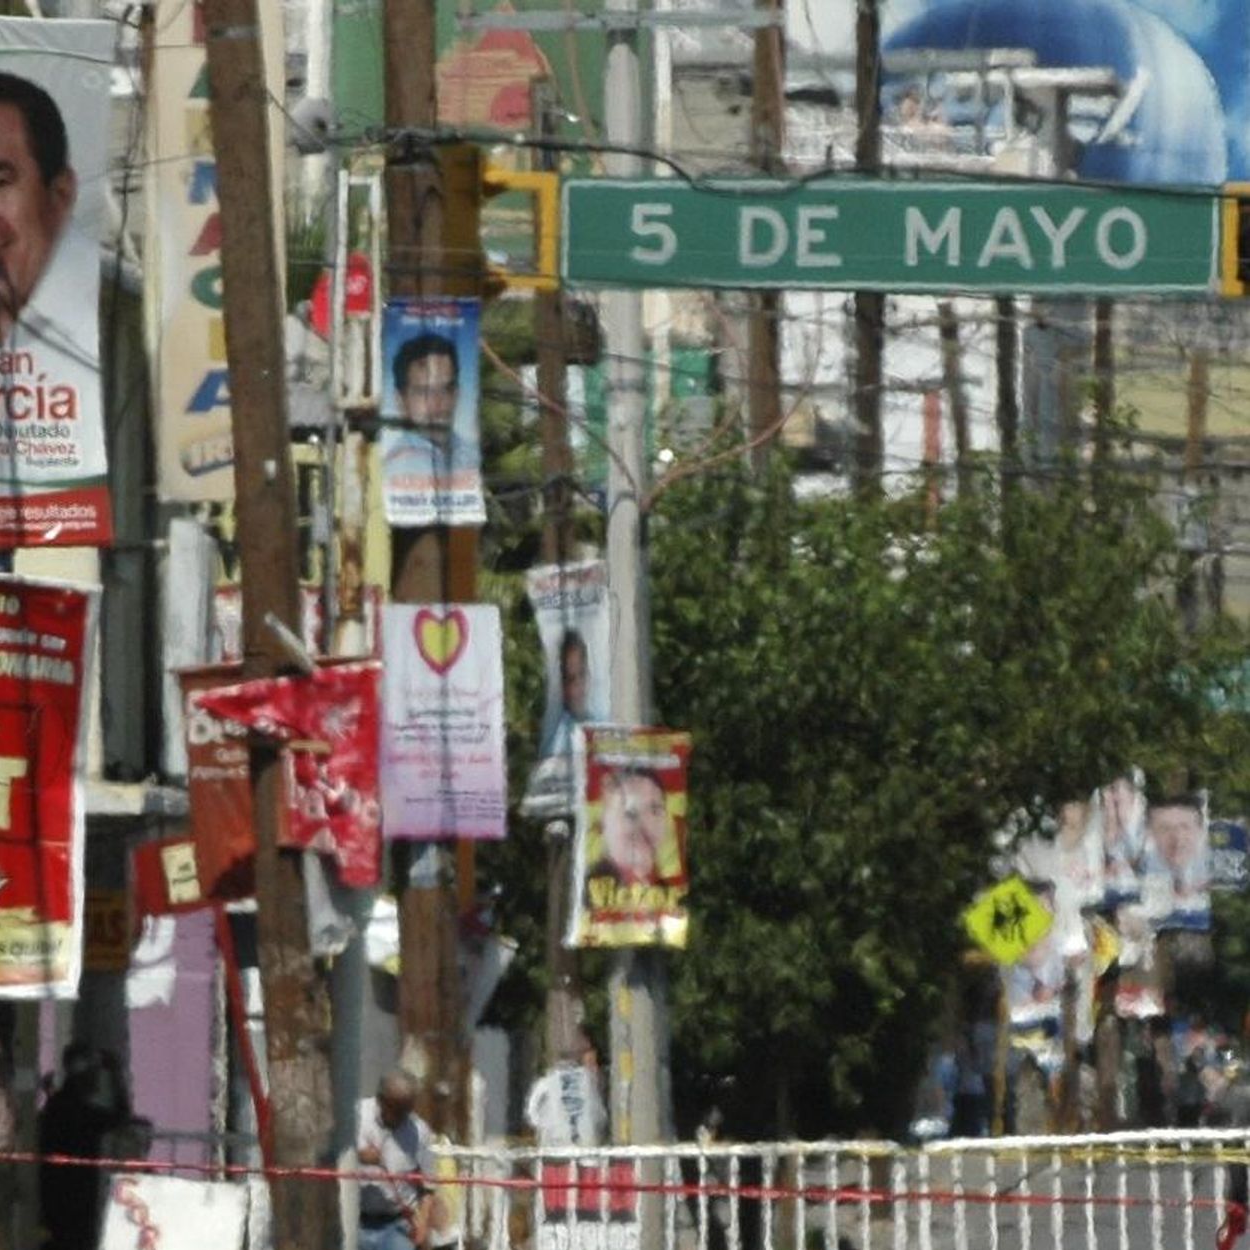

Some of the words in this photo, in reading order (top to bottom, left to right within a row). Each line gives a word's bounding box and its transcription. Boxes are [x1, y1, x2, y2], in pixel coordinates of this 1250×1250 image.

[629, 204, 677, 266] 5
[737, 205, 842, 268] DE
[904, 204, 1149, 270] MAYO
